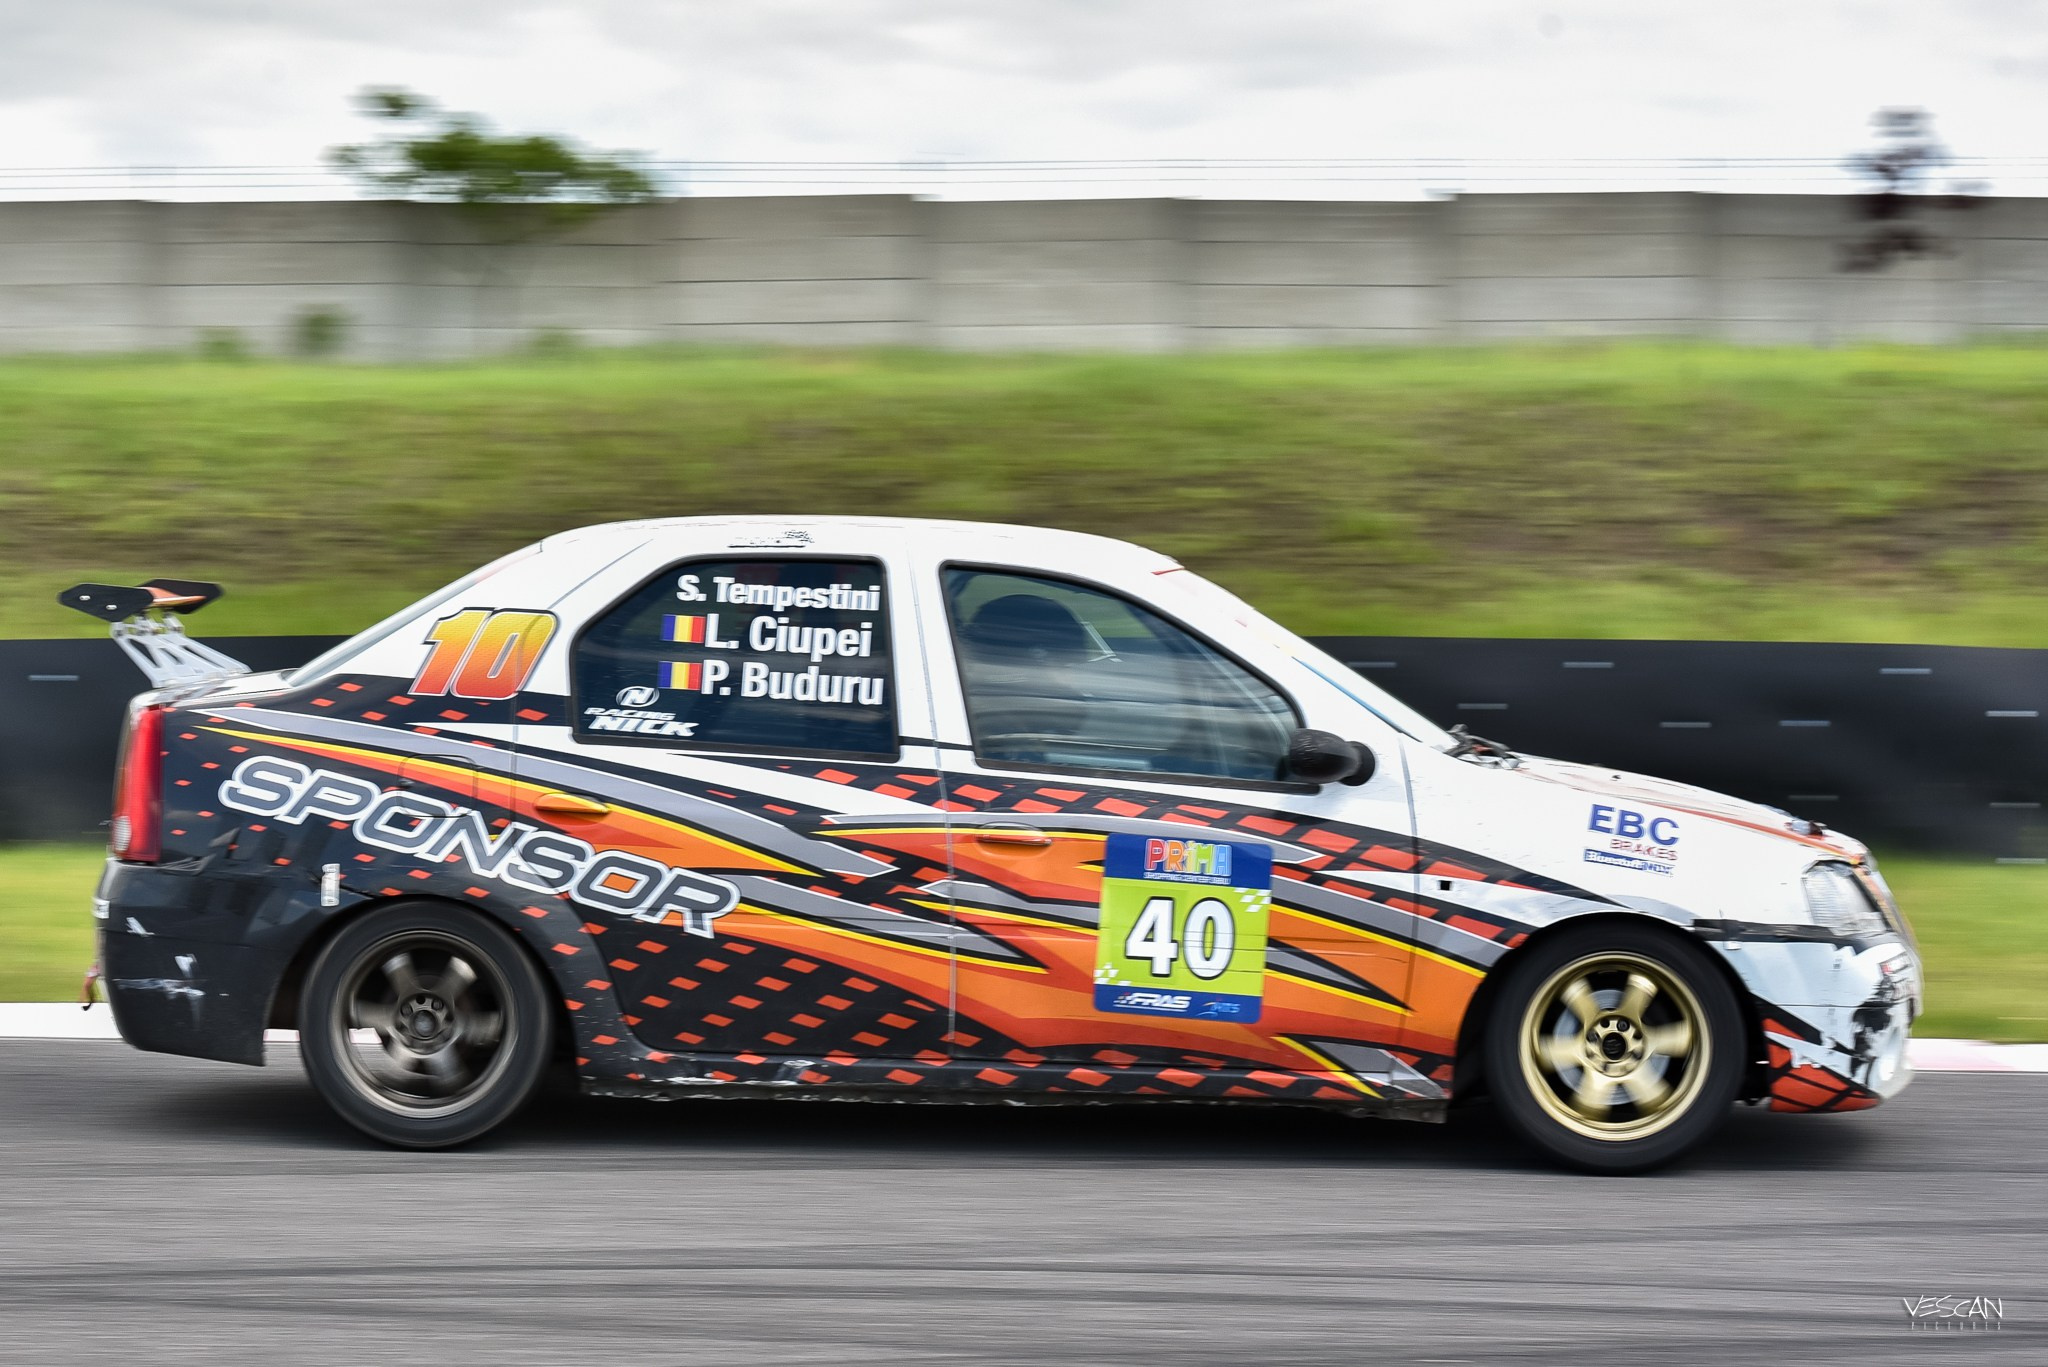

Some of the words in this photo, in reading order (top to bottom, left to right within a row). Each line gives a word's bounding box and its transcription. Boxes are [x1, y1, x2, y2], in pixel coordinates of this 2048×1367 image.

[676, 574, 707, 602] S.
[712, 576, 881, 612] Tempestini
[408, 607, 558, 700] 10
[704, 613, 739, 650] L.
[749, 615, 873, 662] Ciupei
[701, 659, 731, 696] P.
[740, 661, 884, 706] Buduru
[588, 715, 700, 737] NICK
[218, 755, 742, 939] SPONSOR
[1588, 803, 1680, 846] EBC
[1610, 838, 1678, 861] BRAKES
[1125, 896, 1236, 981] 40
